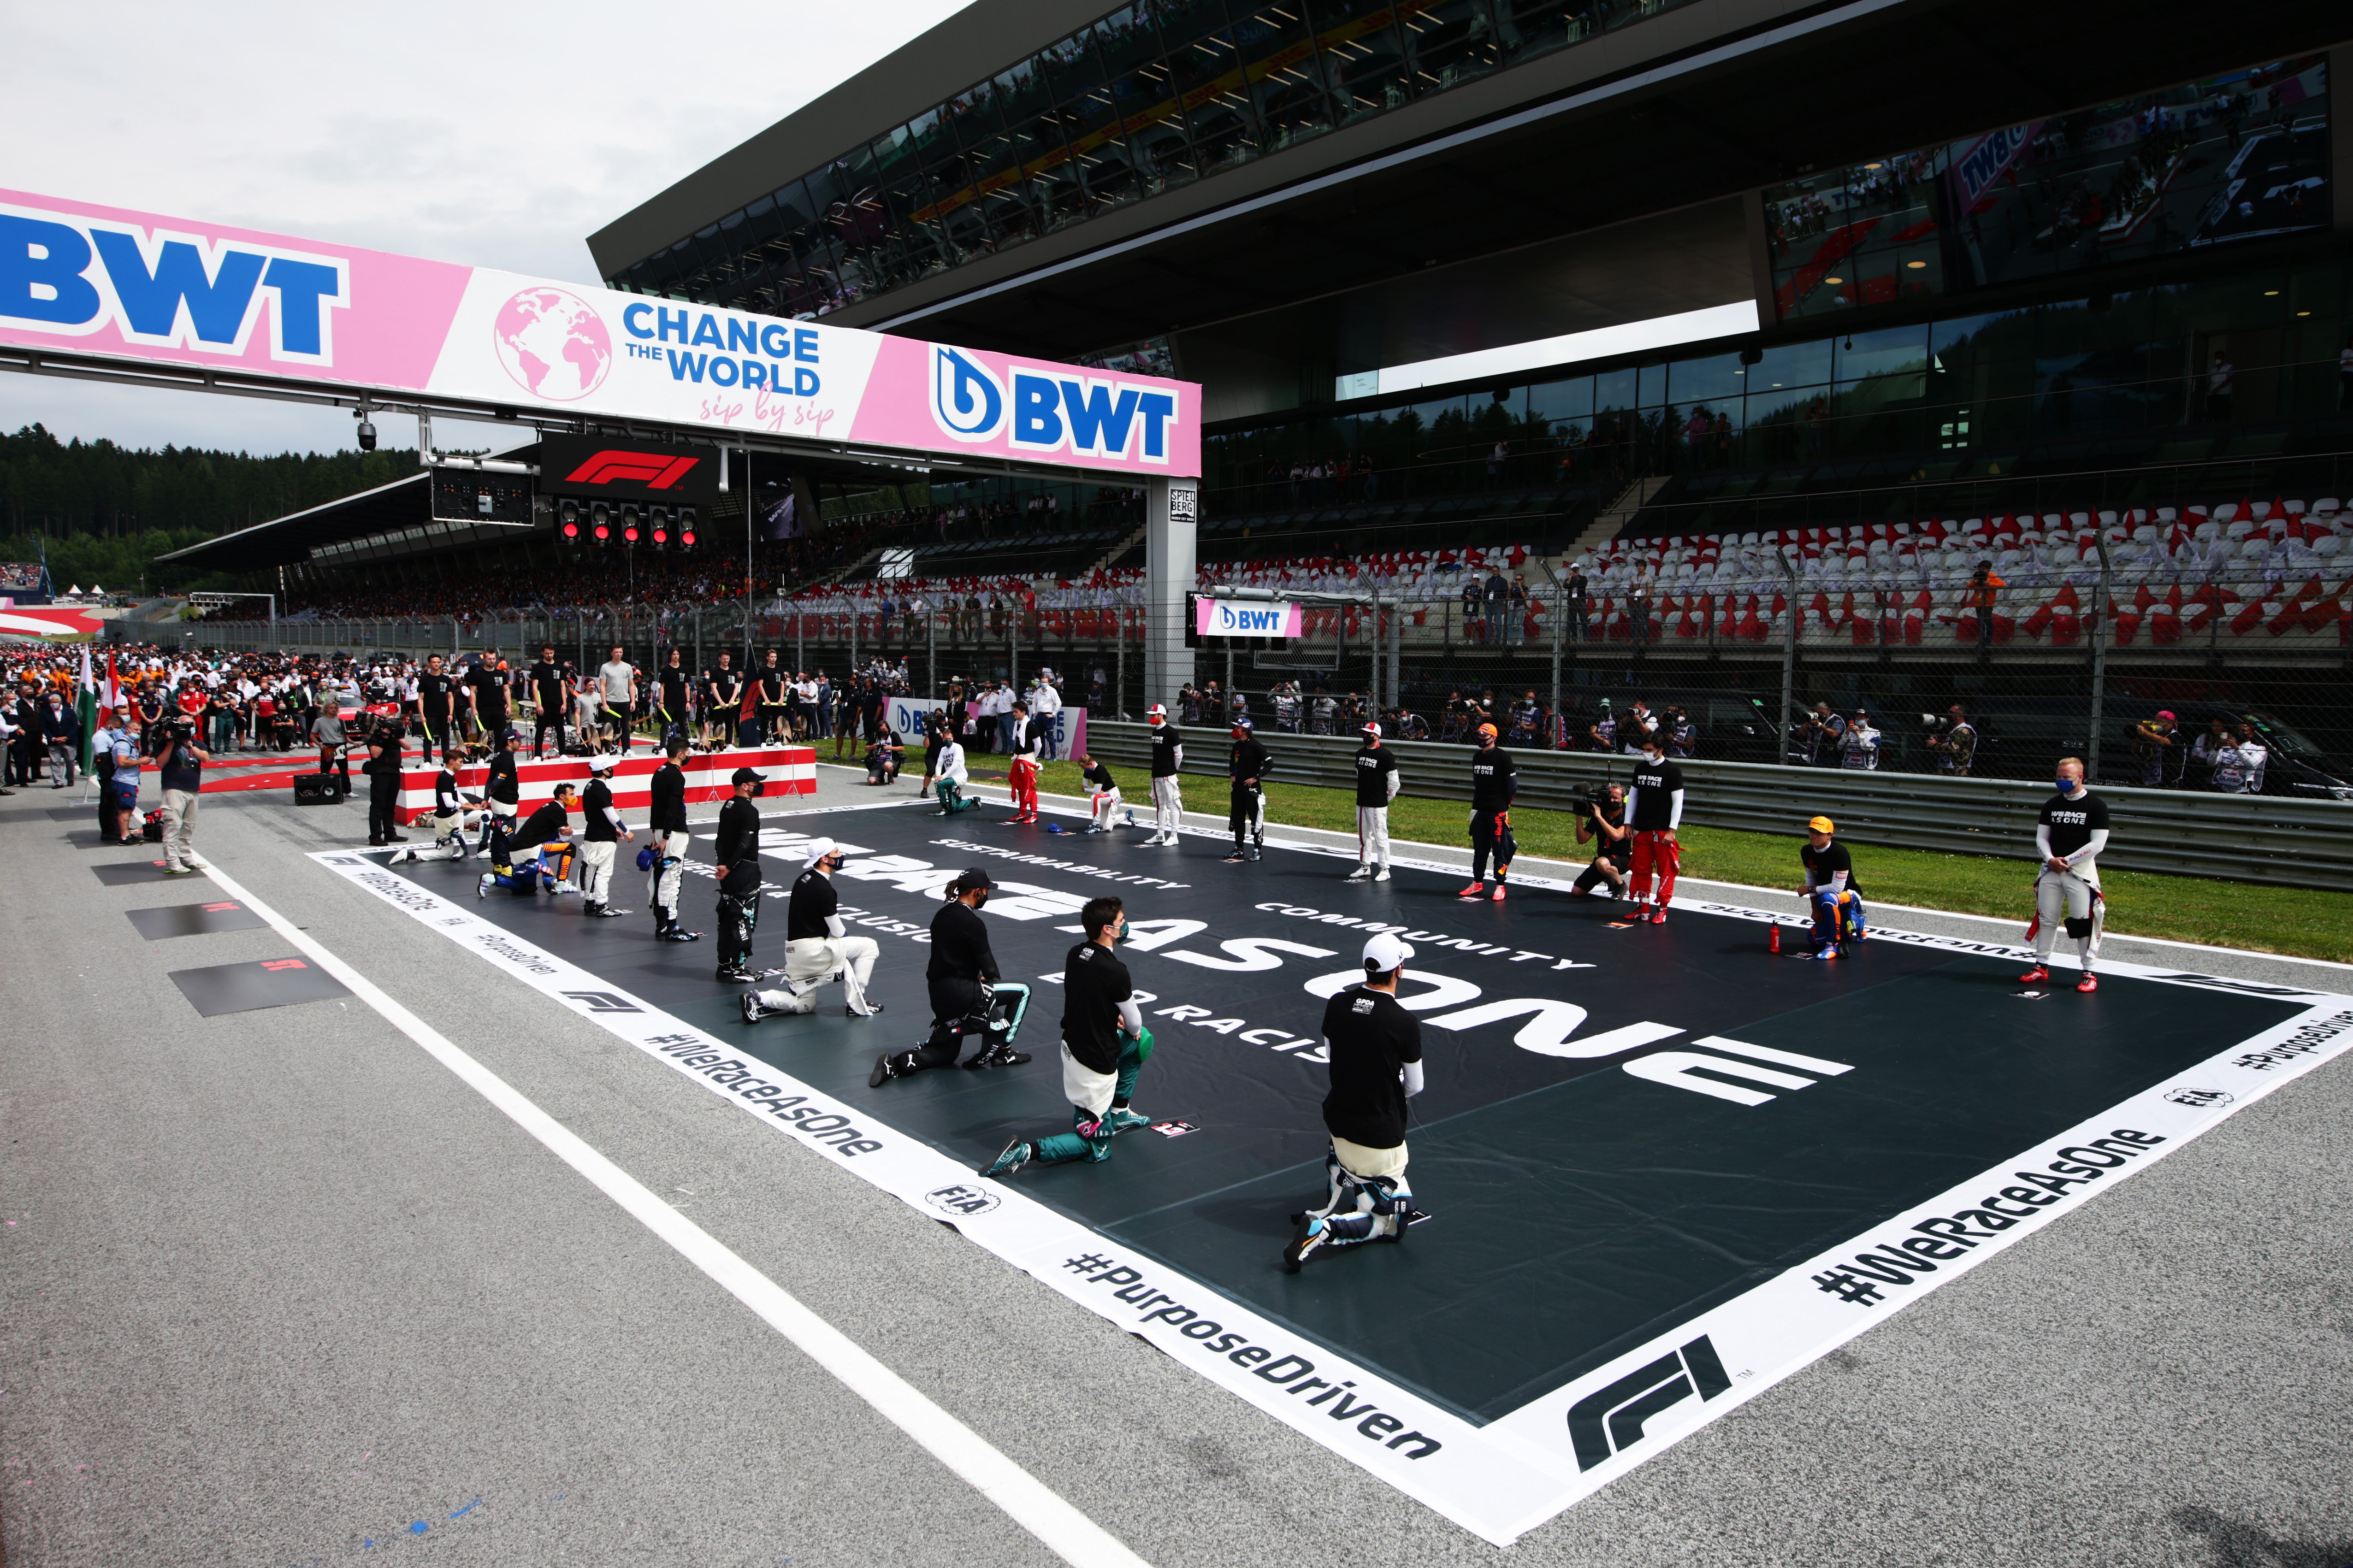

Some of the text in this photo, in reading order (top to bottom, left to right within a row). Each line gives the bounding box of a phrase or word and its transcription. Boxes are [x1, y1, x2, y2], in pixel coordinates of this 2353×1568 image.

[0, 214, 338, 355] BWT
[623, 302, 819, 363] CHANGE
[625, 343, 820, 396] THE WORLD
[700, 381, 834, 436] sip by sip
[1016, 374, 1172, 457] BWT
[1171, 490, 1194, 501] SPIEL
[1171, 501, 1192, 512] BERG
[1239, 611, 1280, 631] BWT
[354, 872, 439, 911] #WeRaceAsOne
[928, 839, 1192, 889] SUSTAINABILITY
[475, 934, 558, 976] #PurposeDriven
[1254, 902, 1597, 970] COMMUNITY
[1054, 919, 1339, 971] AS
[1304, 969, 1856, 1106] ONE
[1356, 998, 1375, 1006] GPDA
[644, 1034, 884, 1157] #WeRaceAsOne
[1811, 1126, 2166, 1308] #WeRaceAsOne
[1062, 1252, 1443, 1461] #PurposeDriven
